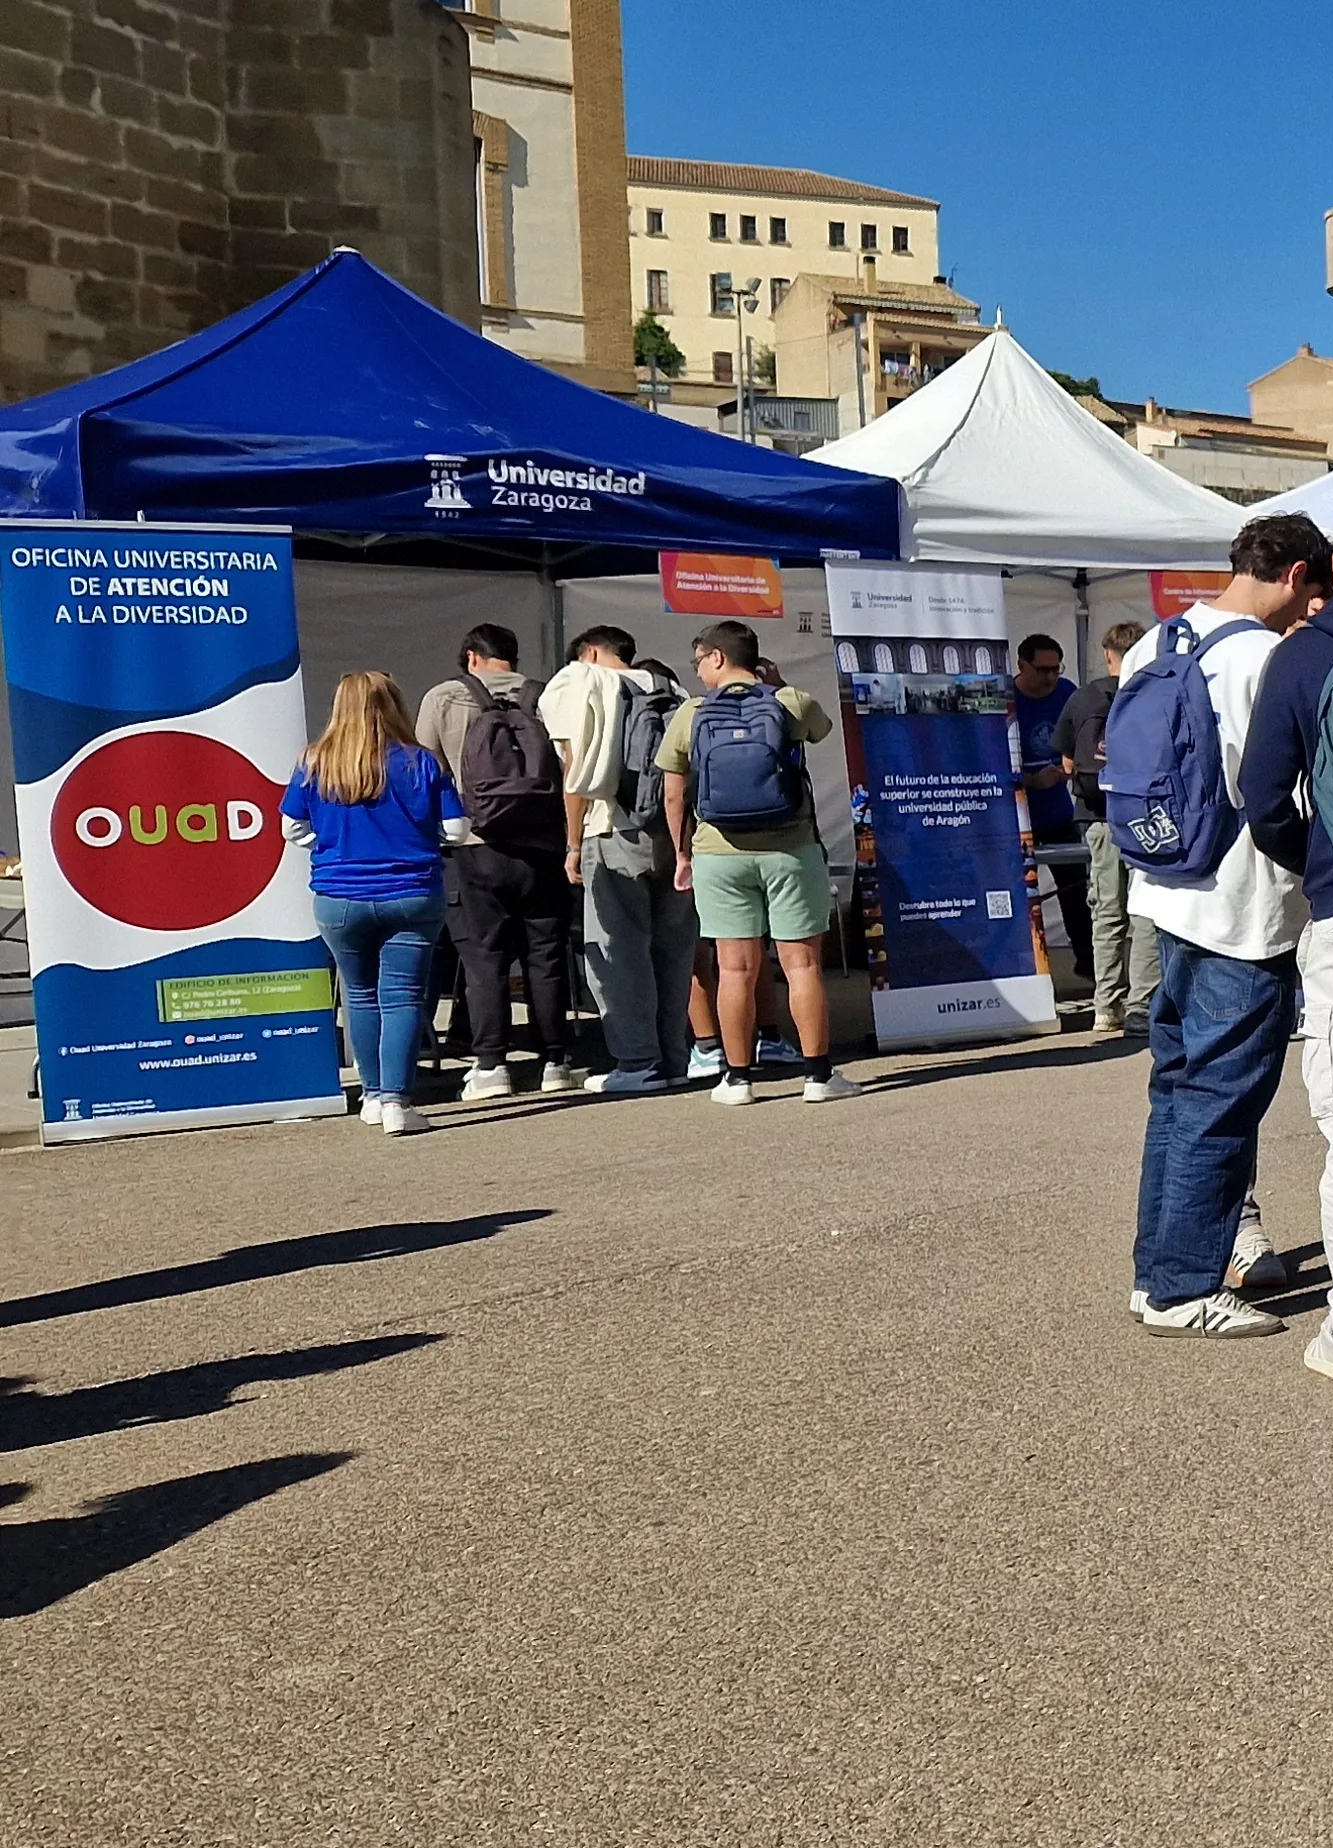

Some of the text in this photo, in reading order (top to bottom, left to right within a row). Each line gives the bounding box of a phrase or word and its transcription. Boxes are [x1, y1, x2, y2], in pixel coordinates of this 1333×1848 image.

[488, 459, 646, 495] Universidad
[490, 486, 593, 512] Zaragoza
[11, 547, 278, 571] OFICINA UNIVERSITARIA
[70, 575, 229, 597] DE ATENCIÓN
[867, 593, 912, 603] Universidad
[55, 605, 247, 624] A LA DIVERSIDAD
[885, 772, 997, 786] El futuro de la educación
[880, 786, 1003, 801] superior se construye en la
[898, 801, 987, 813] universidad pública
[922, 814, 971, 827] de Aragón
[935, 898, 953, 908] todo
[928, 909, 962, 920] aprender
[937, 997, 1001, 1013] unizar.es
[139, 1052, 258, 1071] www.ouad.unizar.es
